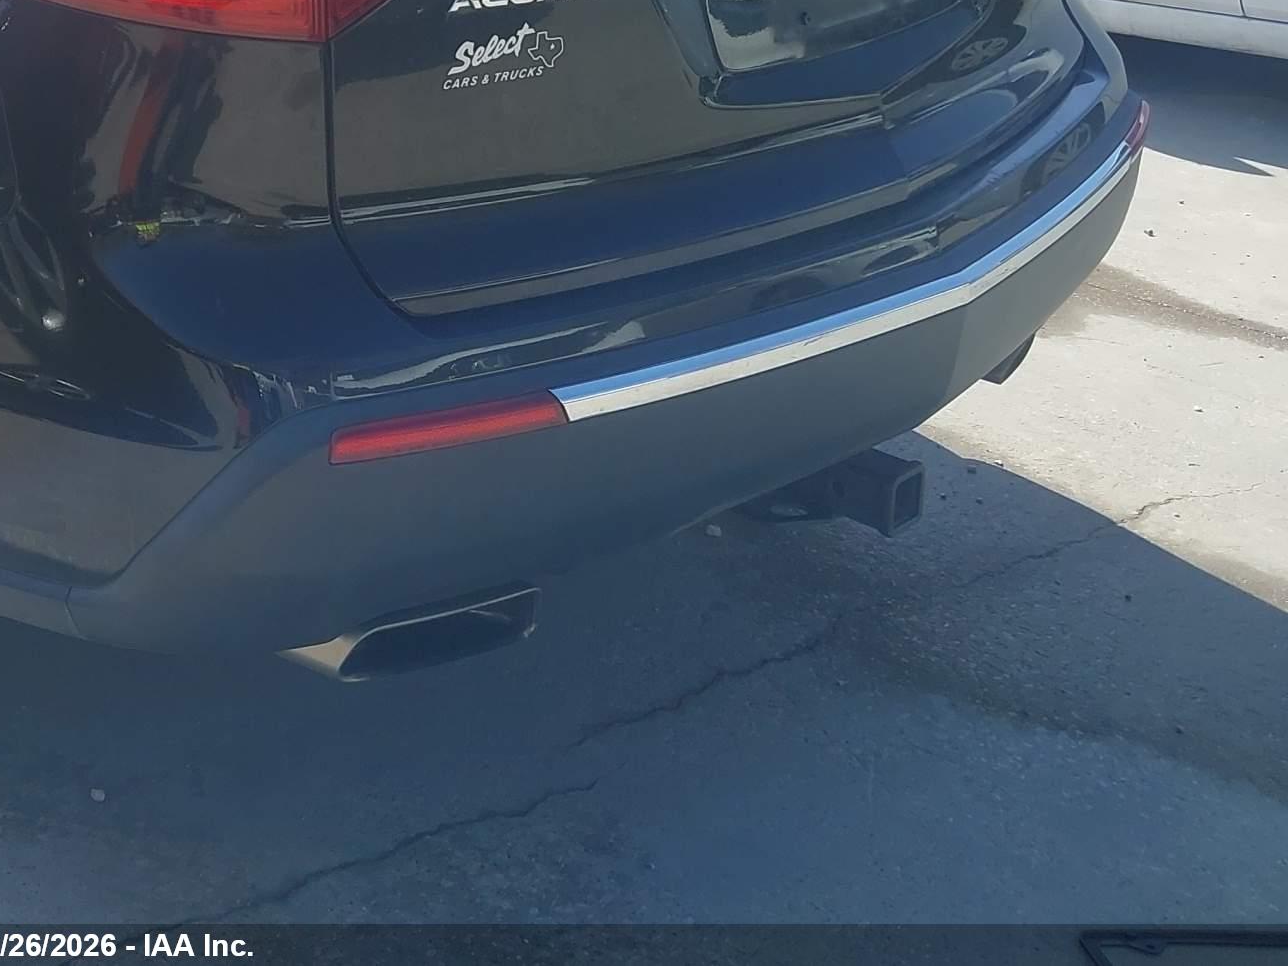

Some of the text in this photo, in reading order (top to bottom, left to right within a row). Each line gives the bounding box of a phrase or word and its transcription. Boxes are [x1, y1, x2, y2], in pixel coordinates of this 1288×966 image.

[447, 22, 535, 76] Select
[443, 66, 544, 90] CARS & TRUCKS
